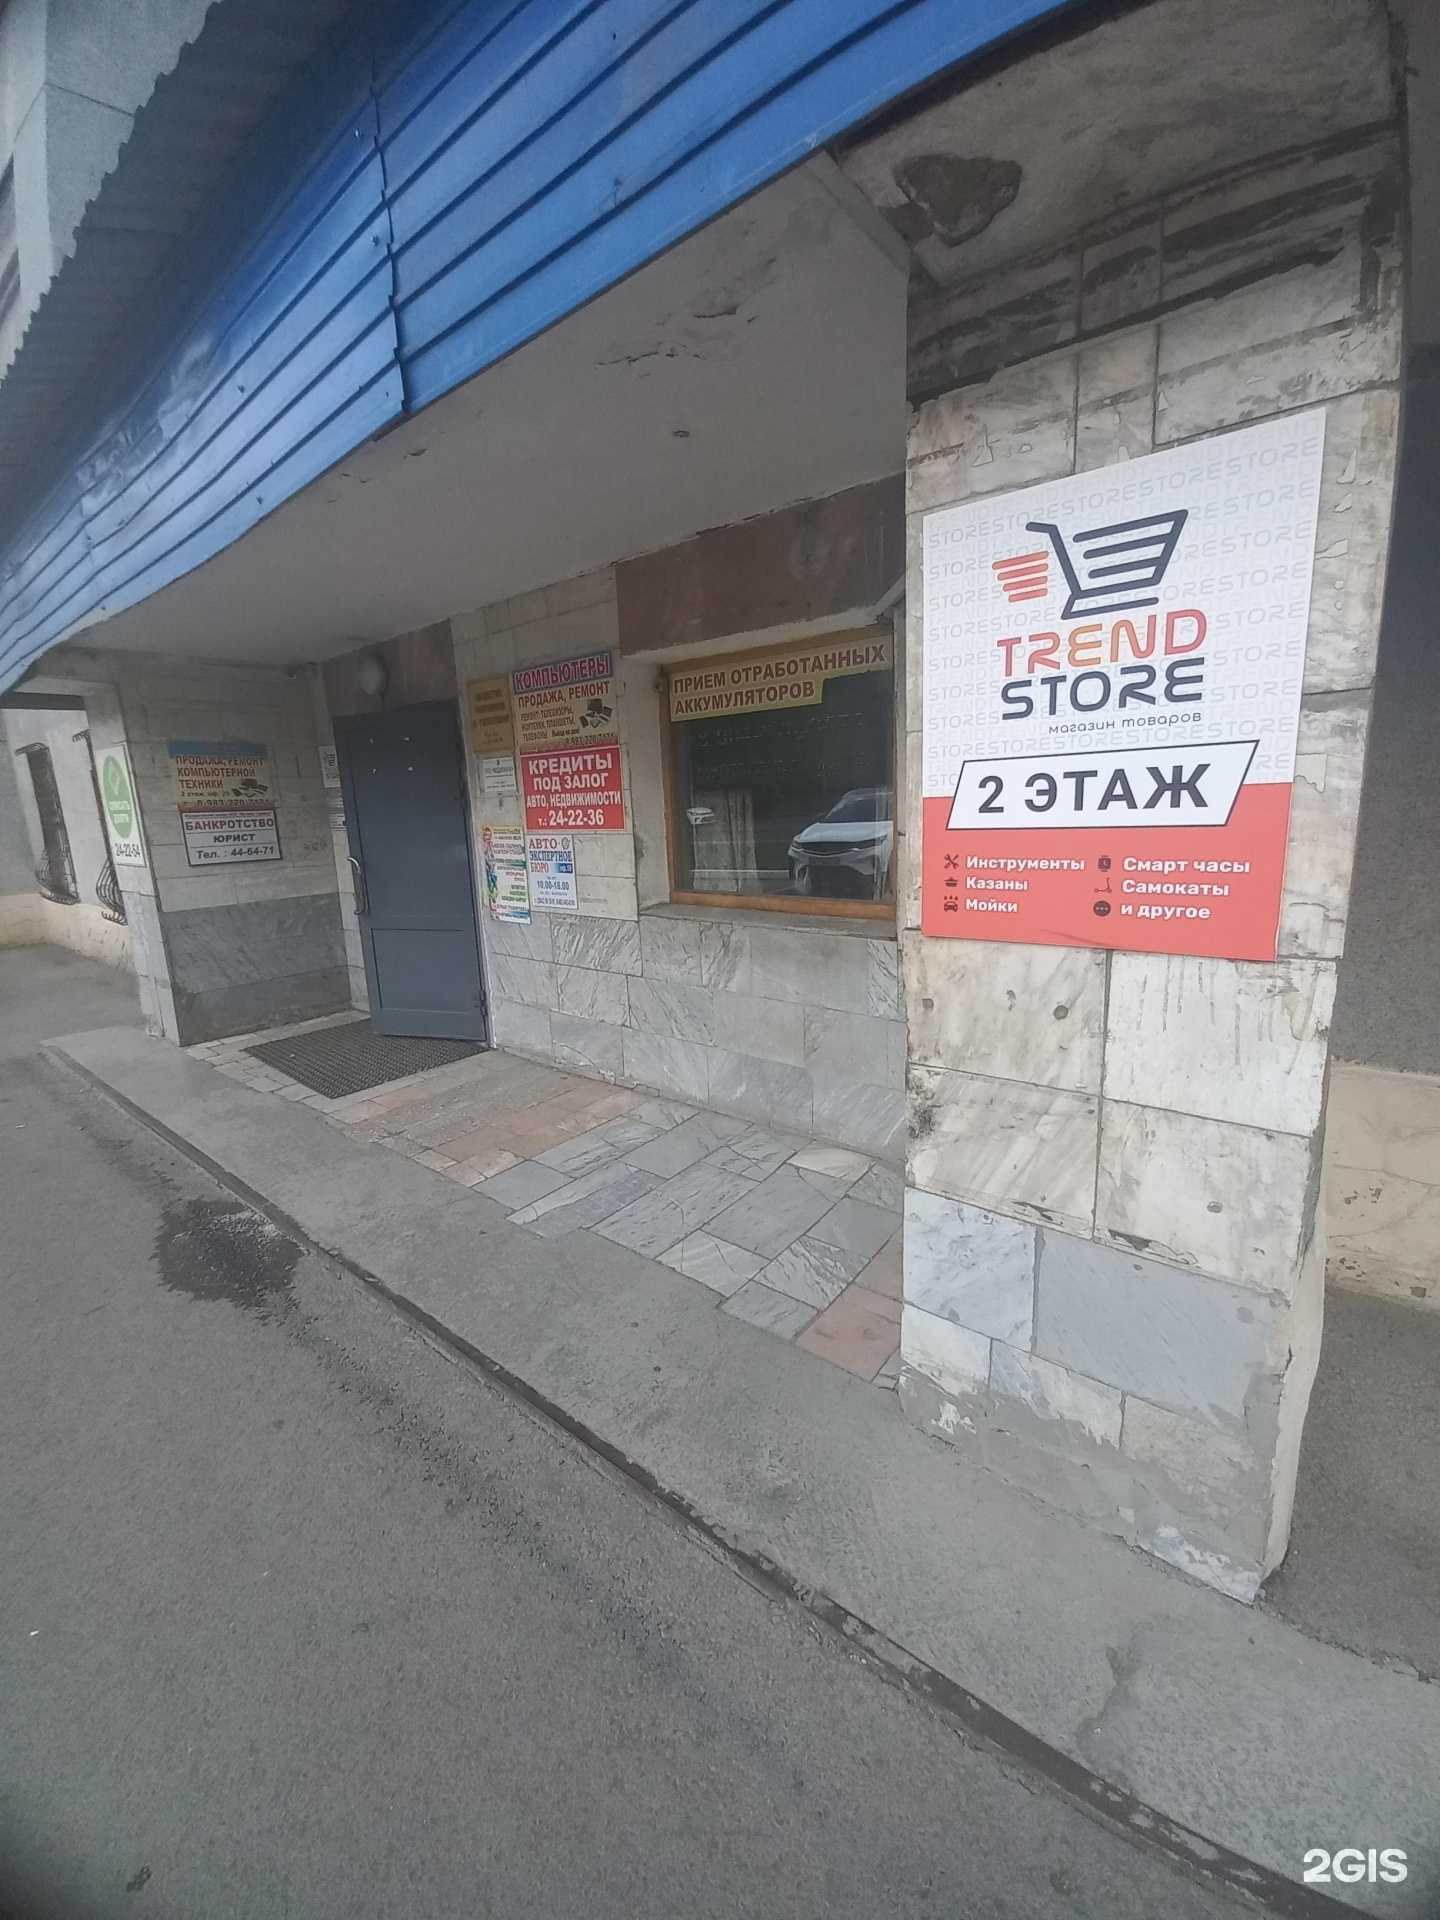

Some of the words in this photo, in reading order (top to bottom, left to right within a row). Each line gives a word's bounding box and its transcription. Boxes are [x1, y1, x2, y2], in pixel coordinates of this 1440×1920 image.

[997, 609, 1207, 678] TREND
[515, 655, 610, 690] КОМПЬЮТЕРЫ
[674, 671, 726, 694] ПРИЕМ
[731, 644, 885, 685] ОТРАБОТАННЫХ
[518, 690, 567, 708] ПРОДАЖА,
[569, 681, 610, 700] РЕМОНТ
[1001, 657, 1205, 720] STORE
[674, 681, 815, 715] АККУМУЛЯТОРОВ
[1048, 719, 1115, 735] магазин
[1121, 711, 1202, 729] товаров
[177, 767, 256, 777] КОМПЬЮТЕРНОЙ
[528, 753, 612, 775] КРЕДИТЫ
[179, 779, 223, 789] ТЕХНИКИ
[533, 776, 561, 792] ПОД
[564, 773, 608, 789] ЗАЛОГ
[978, 774, 1005, 813] 2
[1023, 763, 1211, 812] ЭТАЖ
[526, 795, 549, 808] АВТО,
[550, 791, 621, 808] НЕДВИЖИМОСТИ
[185, 818, 274, 831] БАНКРОТСТВО
[548, 809, 604, 826] 24-22-36
[213, 833, 255, 843] ЮРИСТ
[529, 838, 557, 849] АВТО
[529, 850, 573, 862] ЭКСПЕРТНОЕ
[966, 855, 1085, 874] Инструменты
[531, 862, 549, 873] БЮРО
[1123, 857, 1188, 876] Смарт
[1193, 859, 1250, 874] часы
[966, 876, 1028, 891] Казаны
[1122, 879, 1230, 897] Самокаты
[965, 898, 1018, 913] Мойки
[1121, 904, 1132, 915] и
[1137, 903, 1211, 920] другое
